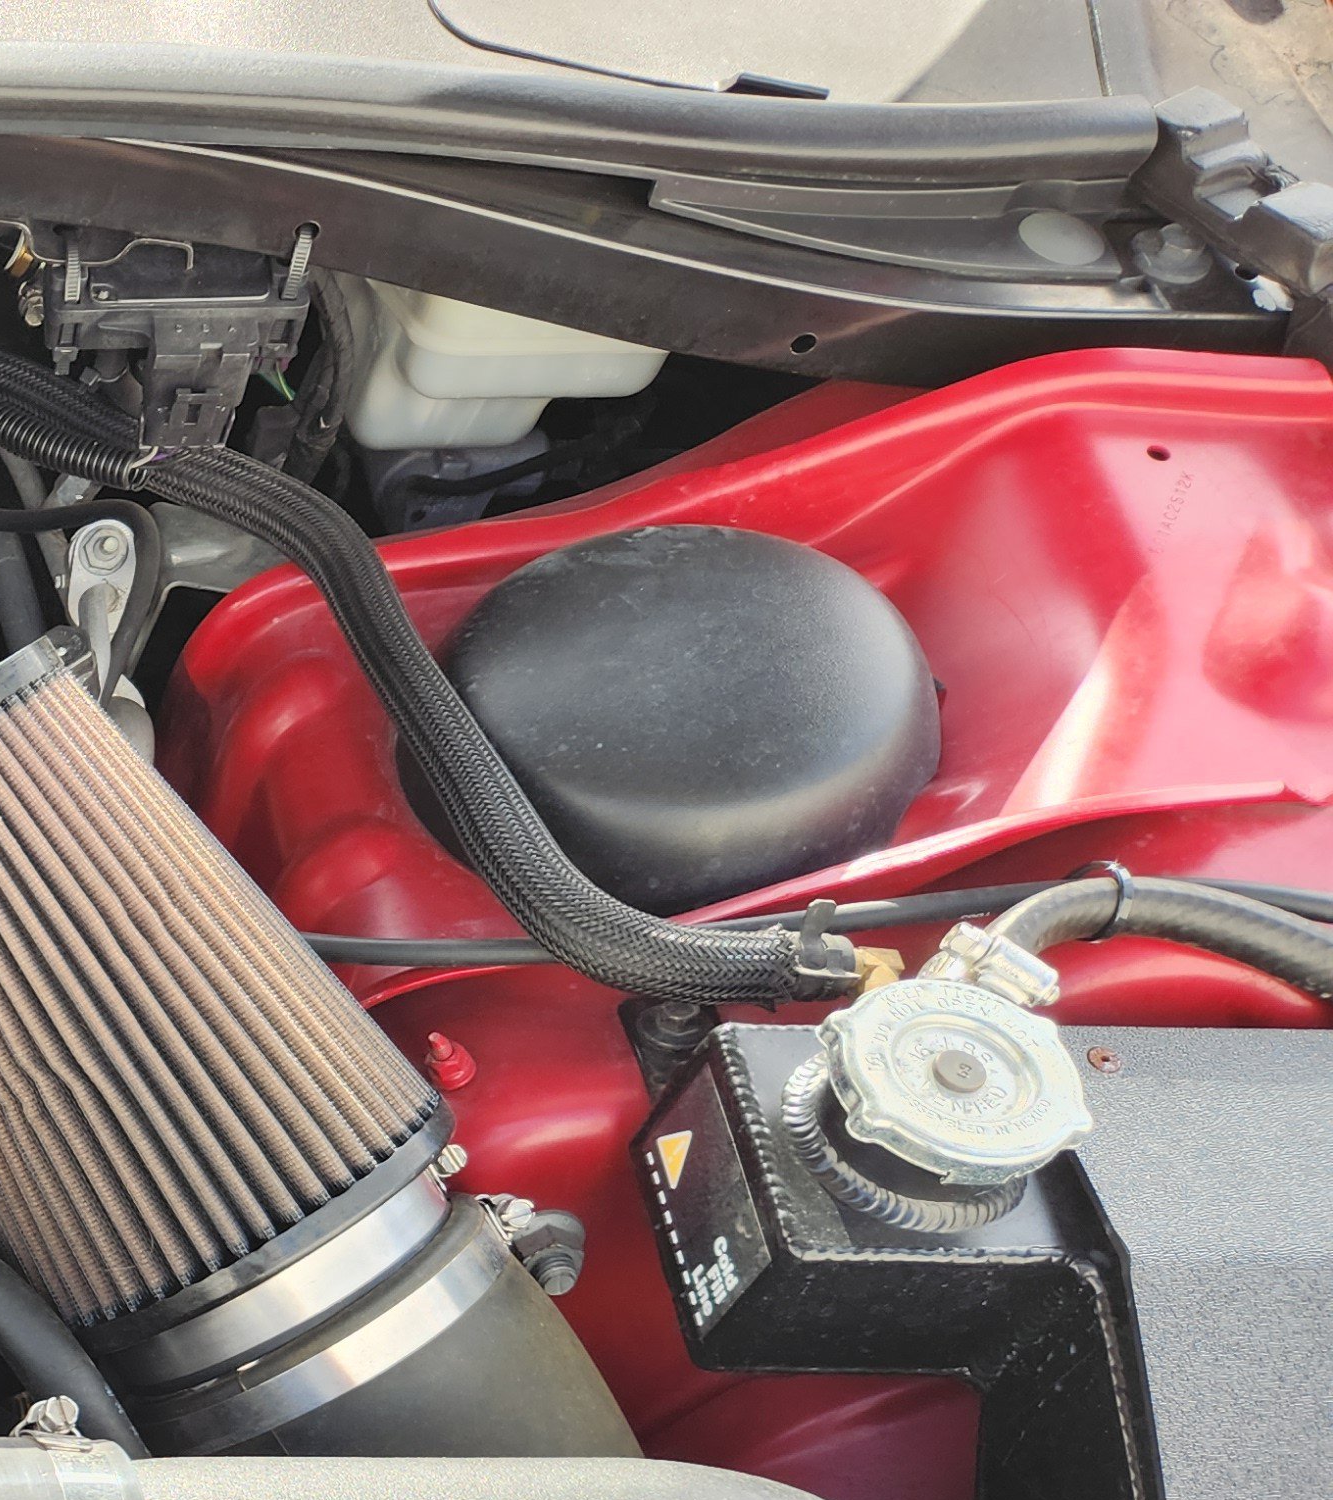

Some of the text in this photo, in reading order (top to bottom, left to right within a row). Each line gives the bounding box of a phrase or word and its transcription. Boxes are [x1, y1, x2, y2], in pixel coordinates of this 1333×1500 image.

[882, 984, 1006, 1011] KEEP TIGHT
[937, 997, 993, 1017] OPEN
[1002, 1020, 1040, 1048] HOT
[993, 1121, 1011, 1136] IN
[1015, 1098, 1052, 1131] MEXICO
[706, 1263, 728, 1305] Fill
[712, 1235, 739, 1292] Cold
[691, 1263, 714, 1317] Line
